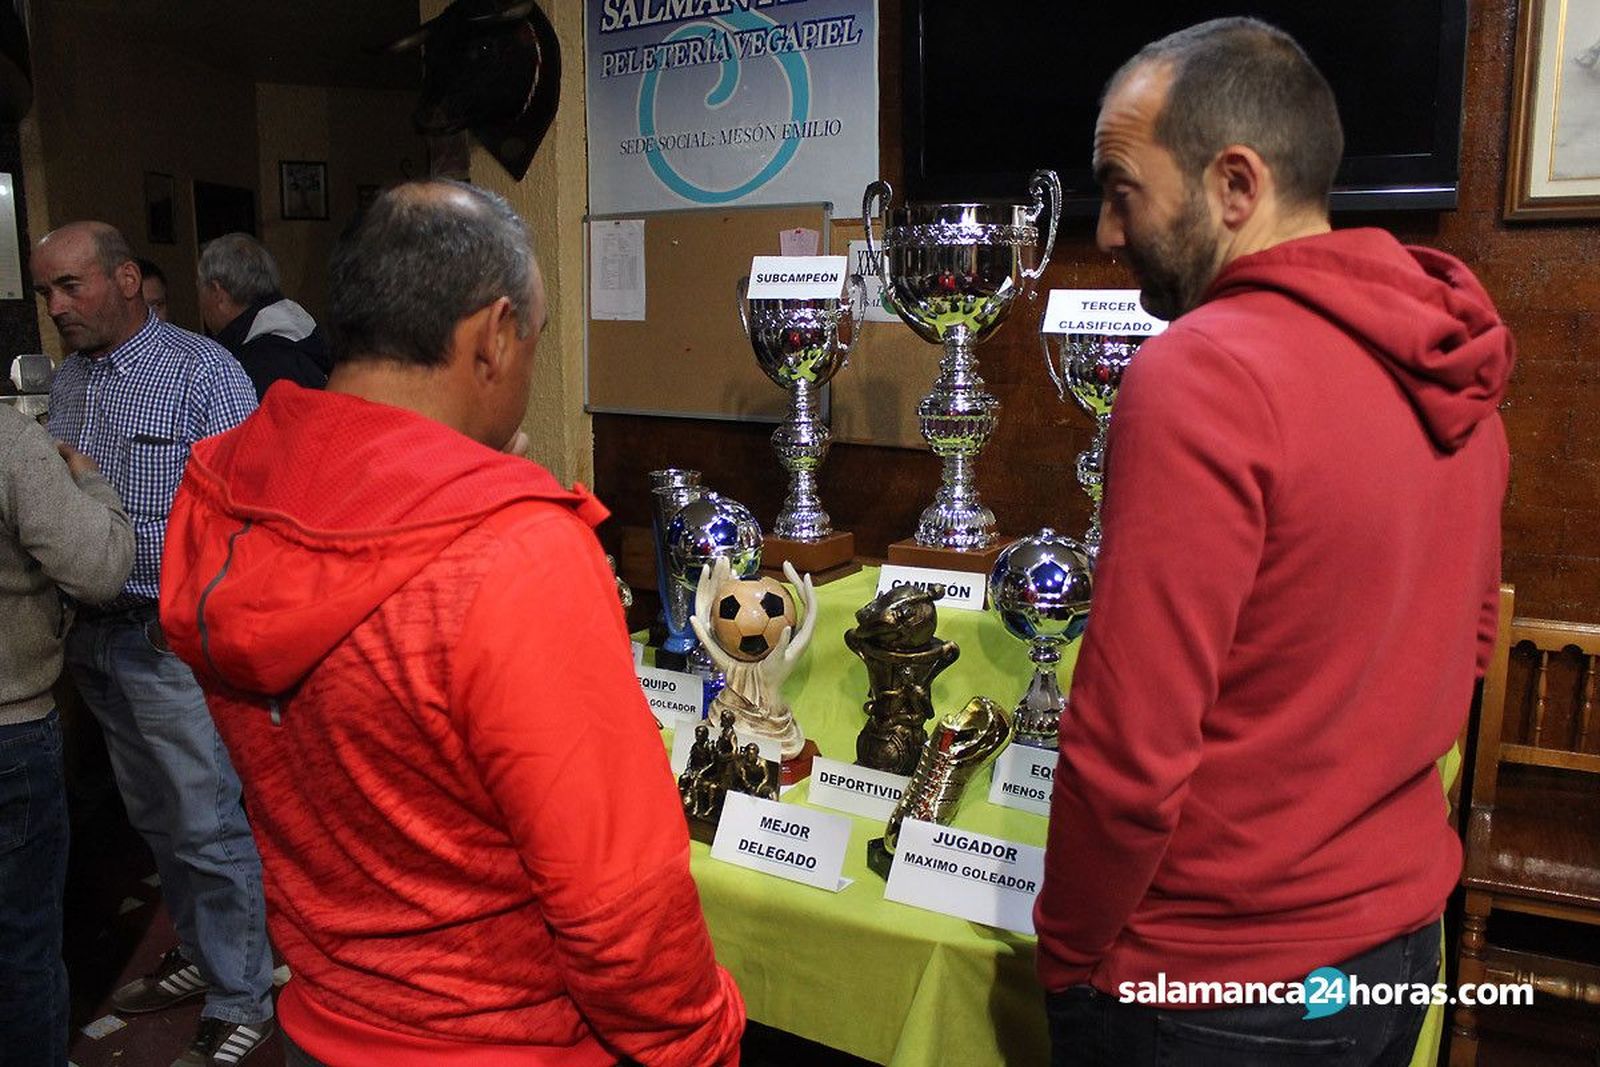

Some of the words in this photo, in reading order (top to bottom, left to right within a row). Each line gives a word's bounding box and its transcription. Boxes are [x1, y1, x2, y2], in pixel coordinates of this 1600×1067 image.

[601, 28, 730, 78] PELETERÍA
[734, 16, 862, 60] VEGAPIEL
[619, 136, 656, 155] SEDE
[658, 131, 715, 152] SOCIAL:
[719, 123, 777, 146] MESÓN
[782, 119, 842, 140] EMILIO
[756, 270, 838, 283] SUBCAMPEÓN
[1081, 301, 1136, 311] TERCER
[1059, 320, 1152, 331] CLASIFICADO
[892, 580, 971, 598] CAMÓN
[650, 698, 697, 713] GOLEADOR
[819, 771, 902, 800] DEPORTIVID
[1002, 782, 1045, 800] MENOS
[760, 816, 810, 839] MEJOR
[738, 838, 817, 869] DELEGADO
[933, 831, 1018, 862] JUGADOR
[904, 851, 958, 874] MAXIMO
[962, 866, 1036, 893] GOLEADOR
